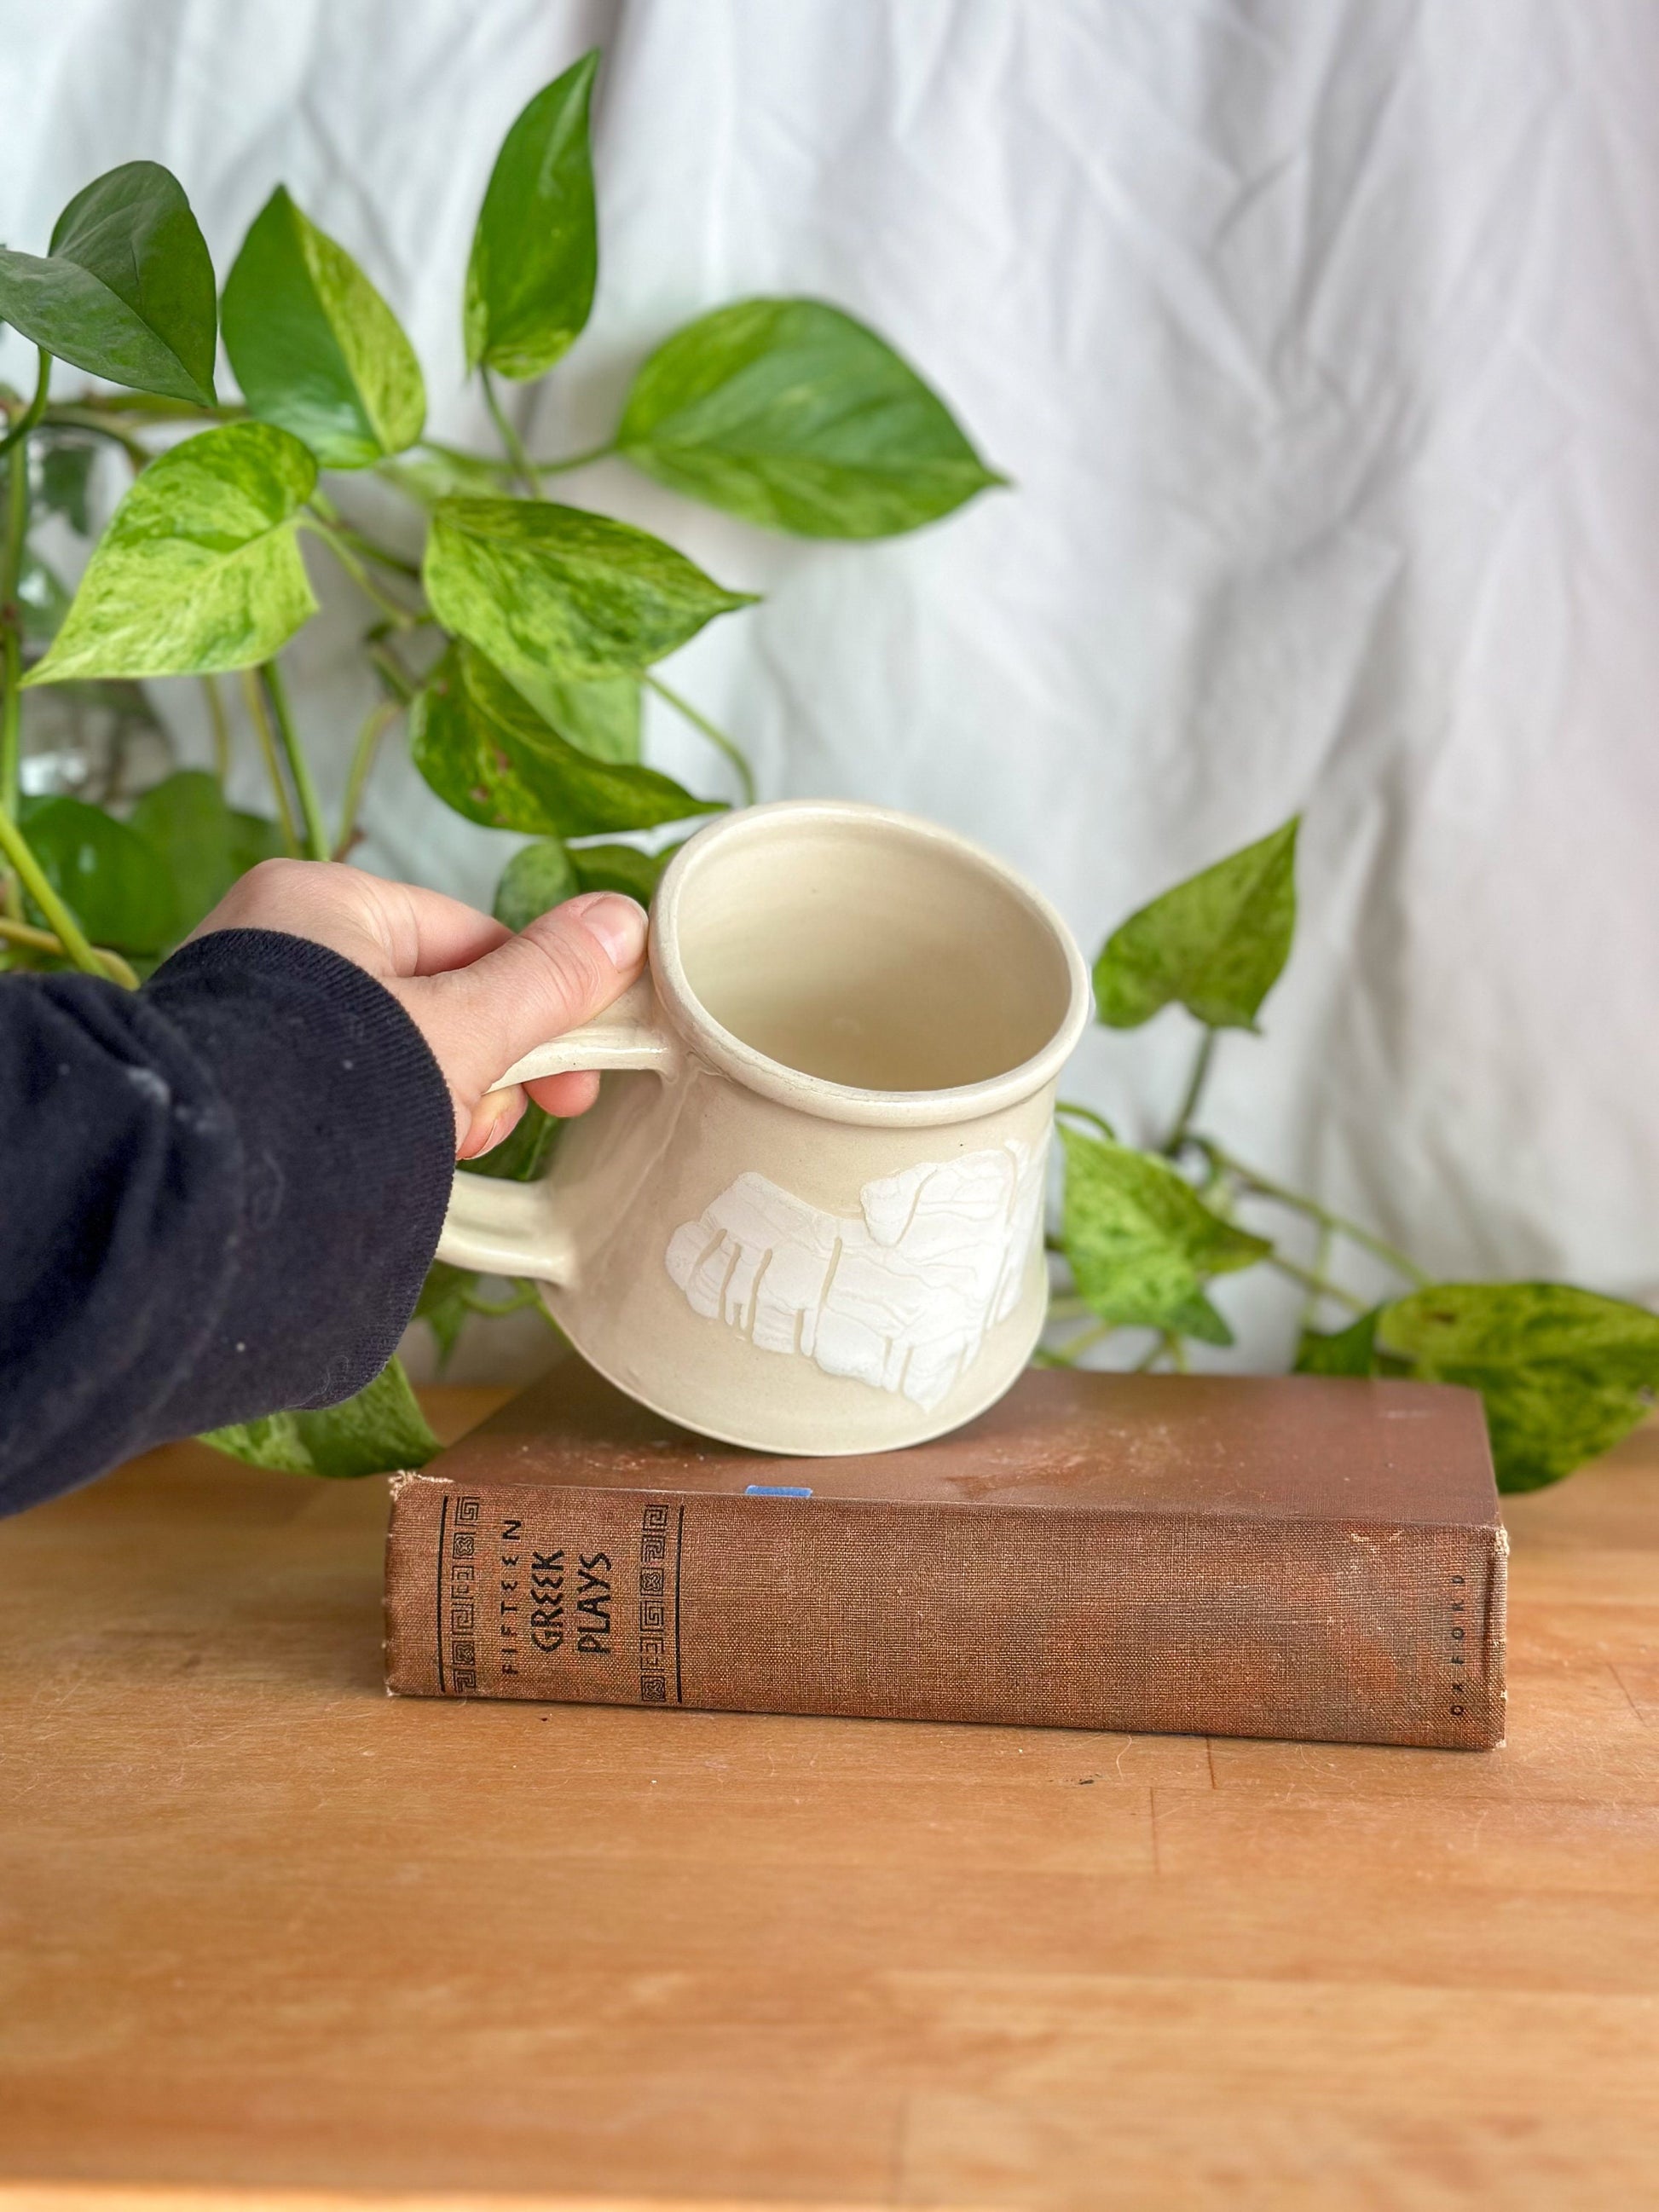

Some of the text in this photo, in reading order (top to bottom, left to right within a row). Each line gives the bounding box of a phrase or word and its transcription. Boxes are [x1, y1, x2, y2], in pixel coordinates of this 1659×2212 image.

[501, 1519, 522, 1676] FIFTEEN
[530, 1550, 565, 1652] GREEK
[576, 1552, 612, 1654] PLAYS
